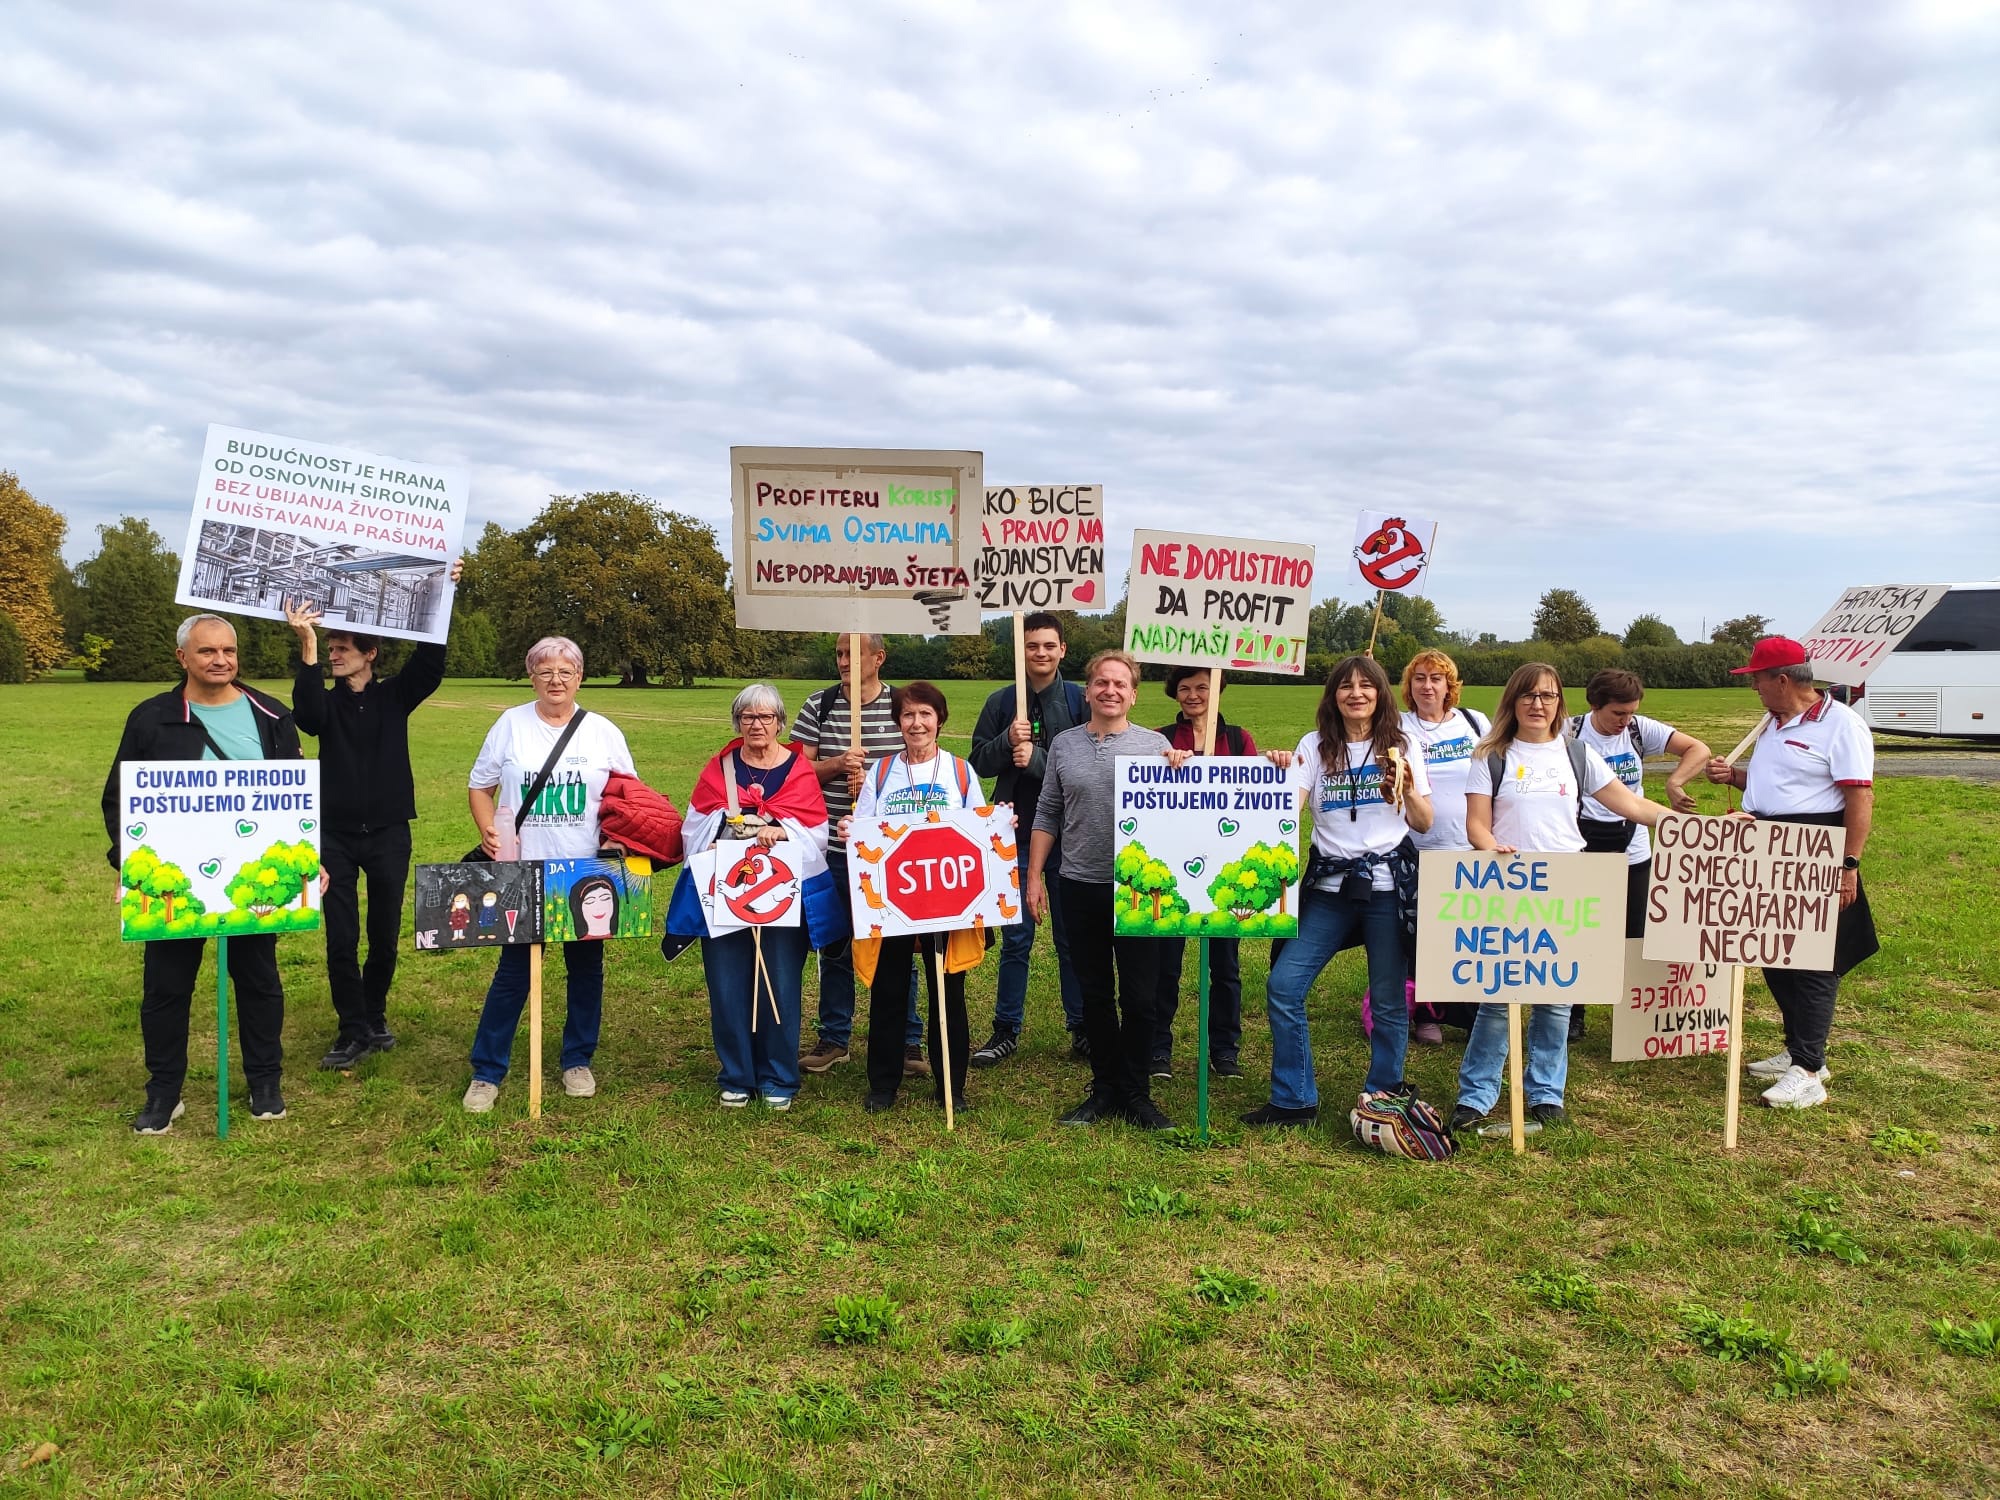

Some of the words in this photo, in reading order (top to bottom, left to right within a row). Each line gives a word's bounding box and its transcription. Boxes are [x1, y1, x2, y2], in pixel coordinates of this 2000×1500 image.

[227, 439, 352, 475] BUDUĆNOST
[354, 463, 376, 479] JE
[379, 468, 446, 492] HRANA
[214, 458, 244, 474] OD
[249, 464, 355, 495] OSNOVNIH
[360, 485, 452, 513] SIROVINA
[756, 482, 879, 508] PROFITERU
[983, 488, 1015, 515] KO
[1028, 486, 1094, 515] BIĆE
[215, 478, 251, 497] BEZ
[255, 485, 344, 513] UBIJANJA
[348, 498, 445, 531] ŽIVOTINJA
[205, 497, 211, 510] I
[216, 499, 348, 534] UNIŠTAVANJA
[353, 523, 447, 552] PRAŠUMA
[757, 517, 831, 544] SVIMA
[844, 516, 952, 544] OSTALIMA
[1001, 518, 1068, 544] PRAVO
[1077, 518, 1103, 543] NA
[981, 546, 1103, 577] TOJANSTVEN
[1140, 543, 1181, 577] NE
[1184, 543, 1313, 588] DOPUSTIMO
[981, 577, 1074, 608] ŽIVOT
[1155, 586, 1188, 616] DA
[1204, 589, 1294, 625] PROFIT
[1835, 587, 1928, 611] HRVATSKA
[1821, 609, 1915, 635] ODLUČNO
[1131, 623, 1230, 656] NADMAŠI
[136, 767, 217, 788] ČUVAMO
[224, 769, 306, 787] PRIRODU
[566, 770, 582, 787] ZA
[1128, 761, 1201, 784] ČUVAMO
[1208, 766, 1287, 784] PRIRODU
[129, 792, 246, 813] POŠTUJEMO
[252, 790, 313, 811] ŽIVOTE
[1122, 787, 1228, 809] POŠTUJEMO
[1234, 788, 1293, 810] ŽIVOTE
[1768, 824, 1834, 859] PLIVA
[898, 855, 975, 894] STOP
[1455, 854, 1548, 891] NAŠE
[1654, 852, 1671, 881] U
[1678, 853, 1763, 892] SMEĆU,
[1771, 861, 1842, 897] FEKALIJE
[1437, 892, 1601, 937] ZDRAVLJE
[1649, 885, 1668, 923] S
[1683, 887, 1829, 932] MEGAFARMI
[416, 929, 439, 949] NE
[1455, 926, 1558, 955] NEMA
[1700, 929, 1796, 965] NEĆU!
[1452, 959, 1578, 995] CIJENU
[1667, 963, 1694, 983] NE
[1631, 984, 1706, 1014] CVIJEĆE
[1655, 1008, 1730, 1032] MIRISATI
